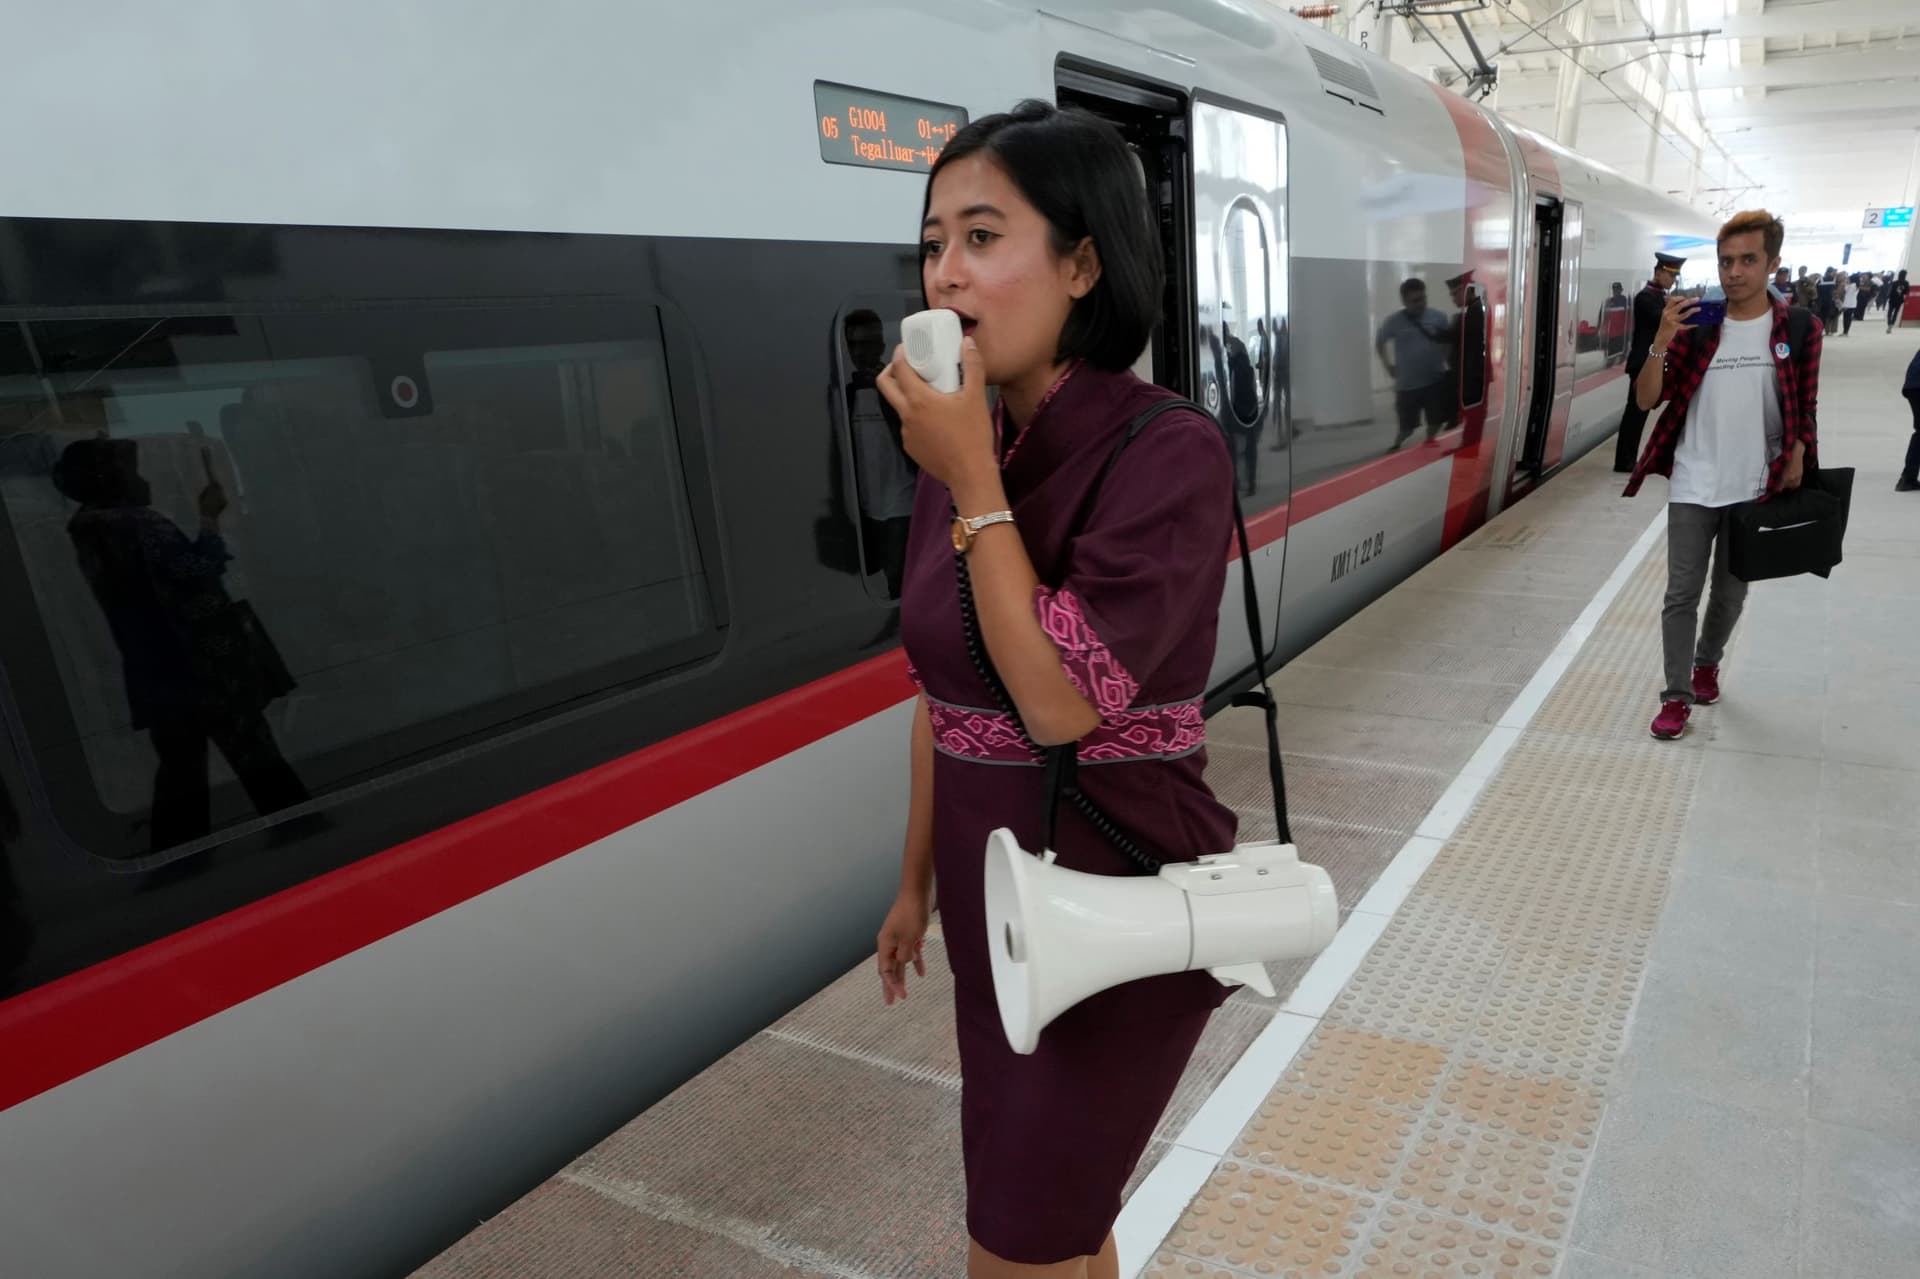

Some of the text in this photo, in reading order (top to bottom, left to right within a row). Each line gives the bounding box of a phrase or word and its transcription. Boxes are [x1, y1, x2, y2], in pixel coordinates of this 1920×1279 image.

[822, 116, 839, 139] 05
[848, 106, 887, 132] G1004
[1869, 213, 1878, 224] 2
